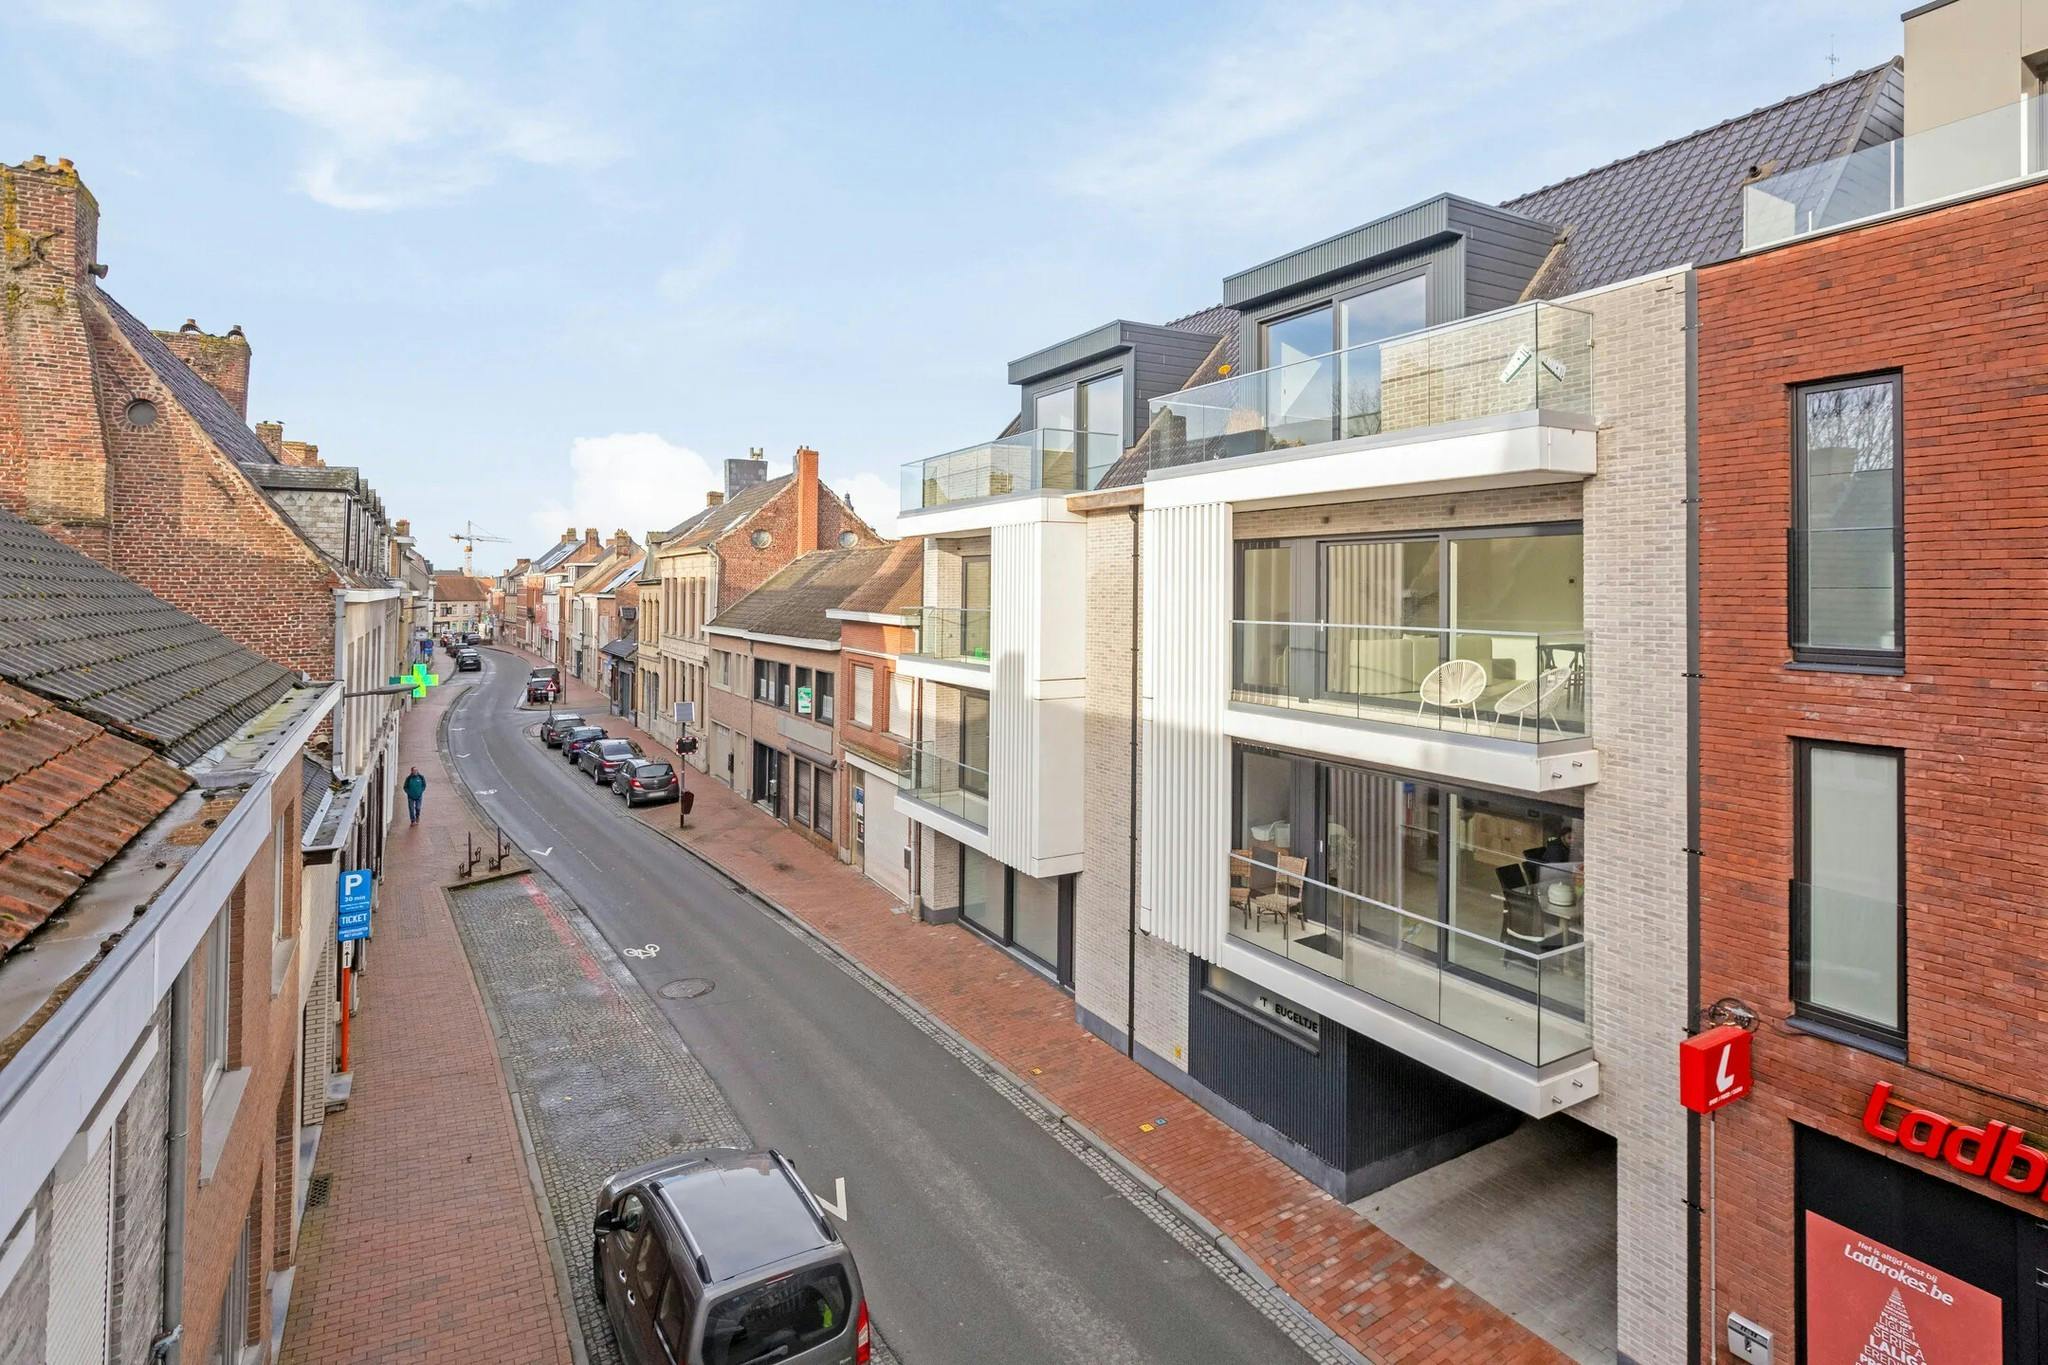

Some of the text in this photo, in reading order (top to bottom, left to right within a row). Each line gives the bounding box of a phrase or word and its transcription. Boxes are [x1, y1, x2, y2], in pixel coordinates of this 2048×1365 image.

[345, 874, 363, 896] P
[342, 913, 368, 925] TICKET
[1862, 1080, 2048, 1203] Ladb
[1844, 1243, 1955, 1306] Ladbrokes.be
[1857, 1240, 1938, 1284] Het is altijd feest bij
[1879, 1315, 1909, 1338] LIGUE
[1869, 1334, 1927, 1365] LALIG
[1873, 1326, 1925, 1361] SERIE A
